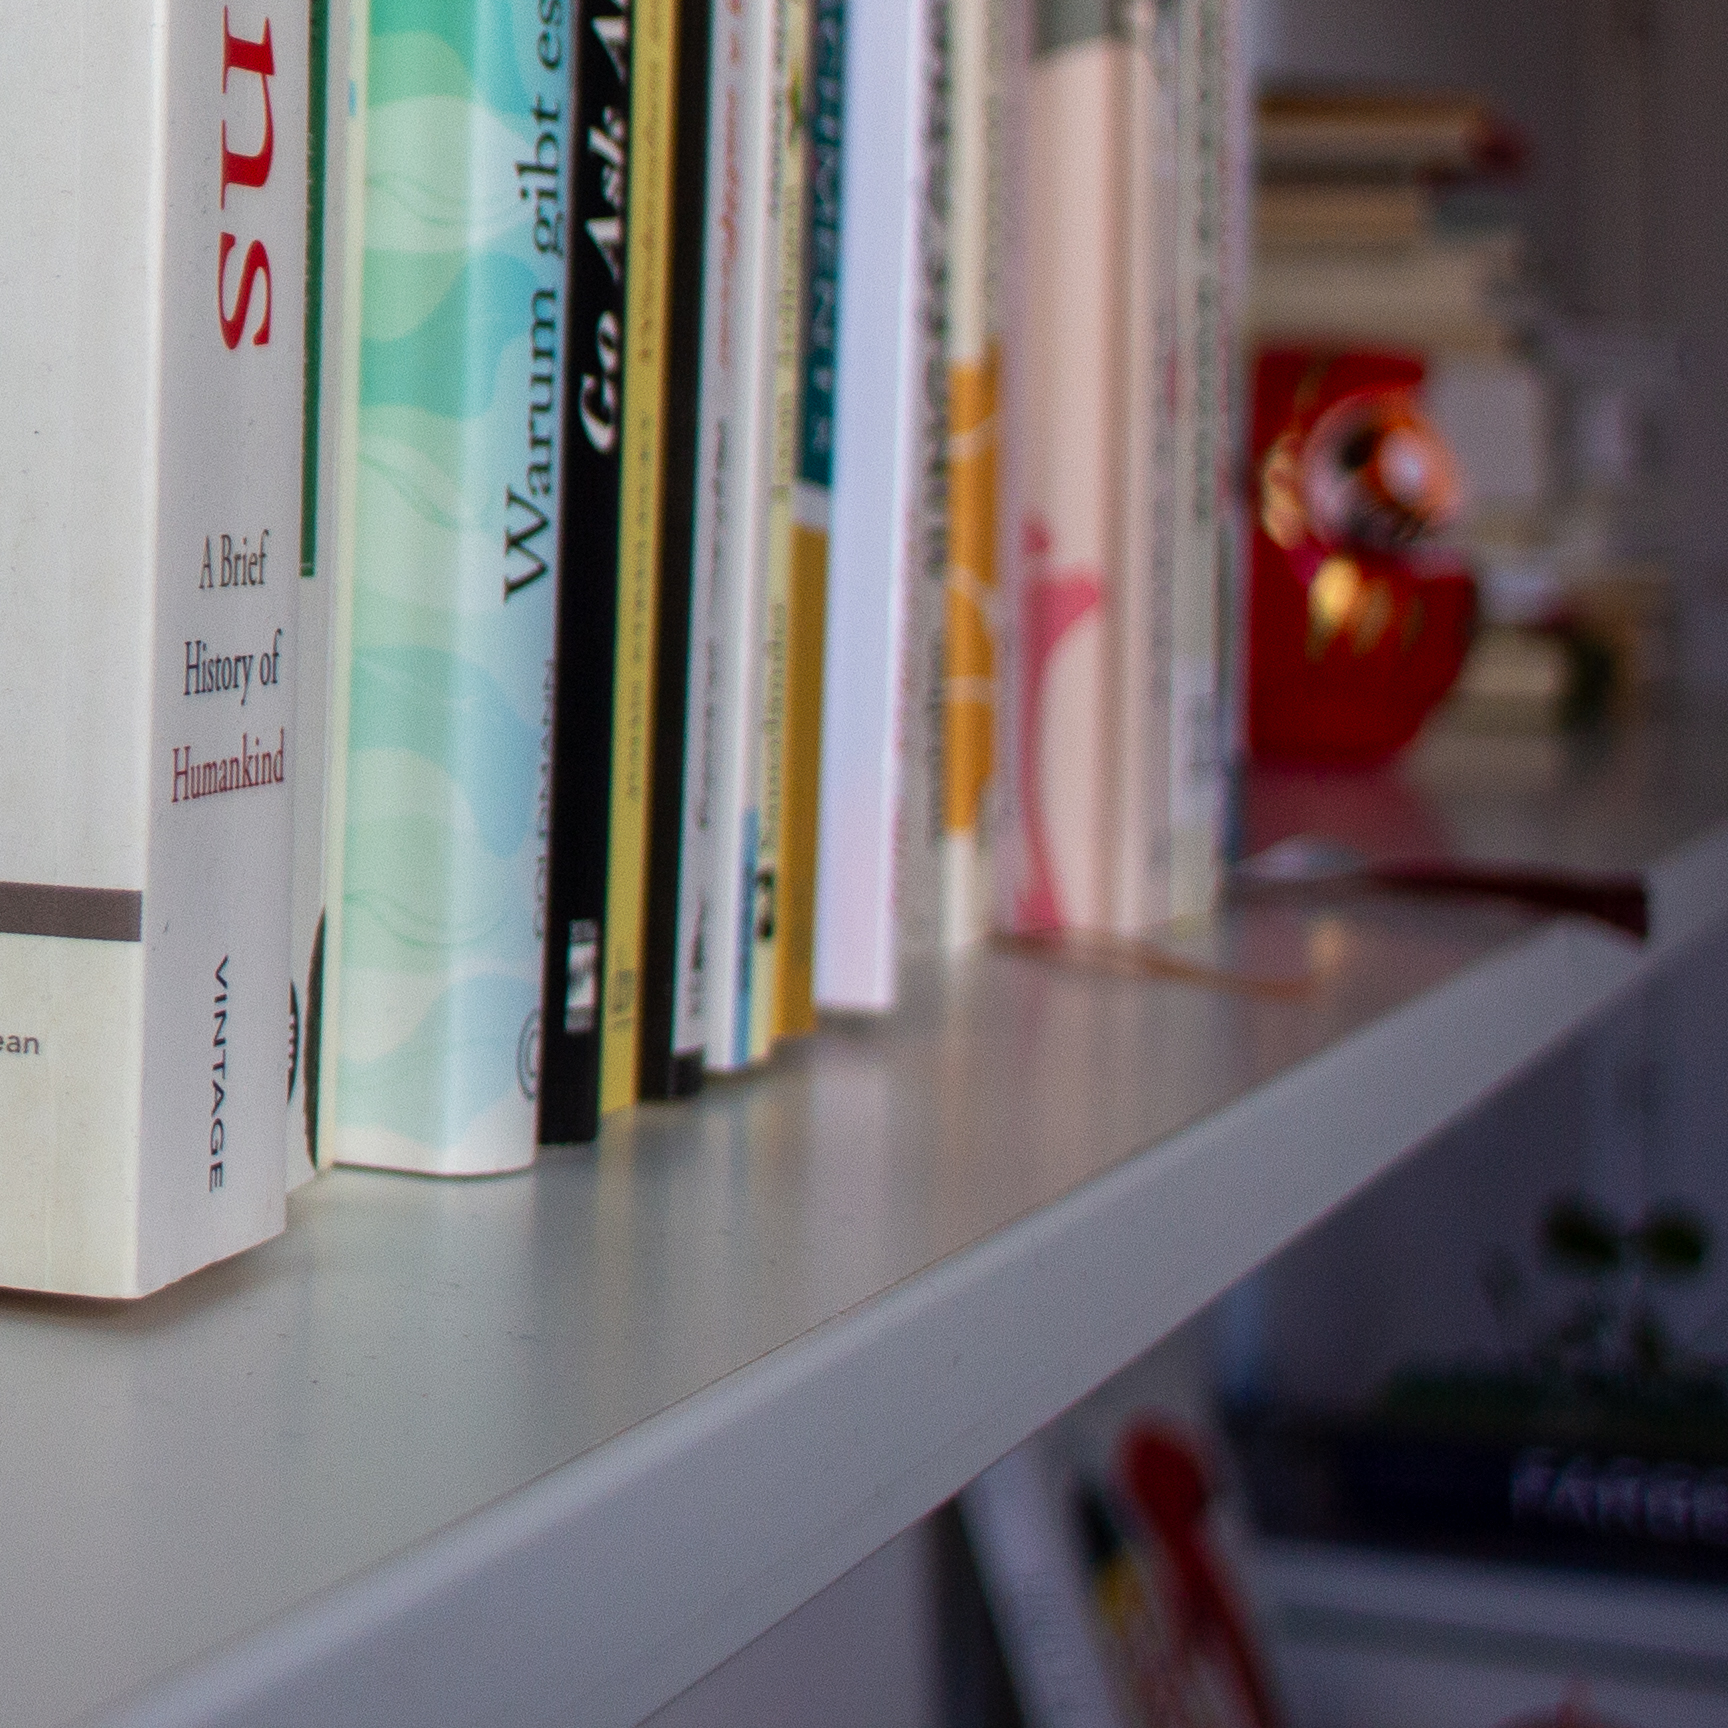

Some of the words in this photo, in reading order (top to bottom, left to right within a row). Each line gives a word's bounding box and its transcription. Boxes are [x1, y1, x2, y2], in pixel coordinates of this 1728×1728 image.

[514, 96, 565, 260] gibt
[583, 106, 628, 287] Ask
[503, 288, 557, 603] Warum
[578, 312, 619, 455] Go
[198, 536, 214, 591] A
[219, 529, 270, 588] Brief
[183, 640, 254, 706] History
[259, 628, 283, 686] of
[170, 727, 285, 806] Humankind
[209, 955, 228, 1192] VINTAGE
